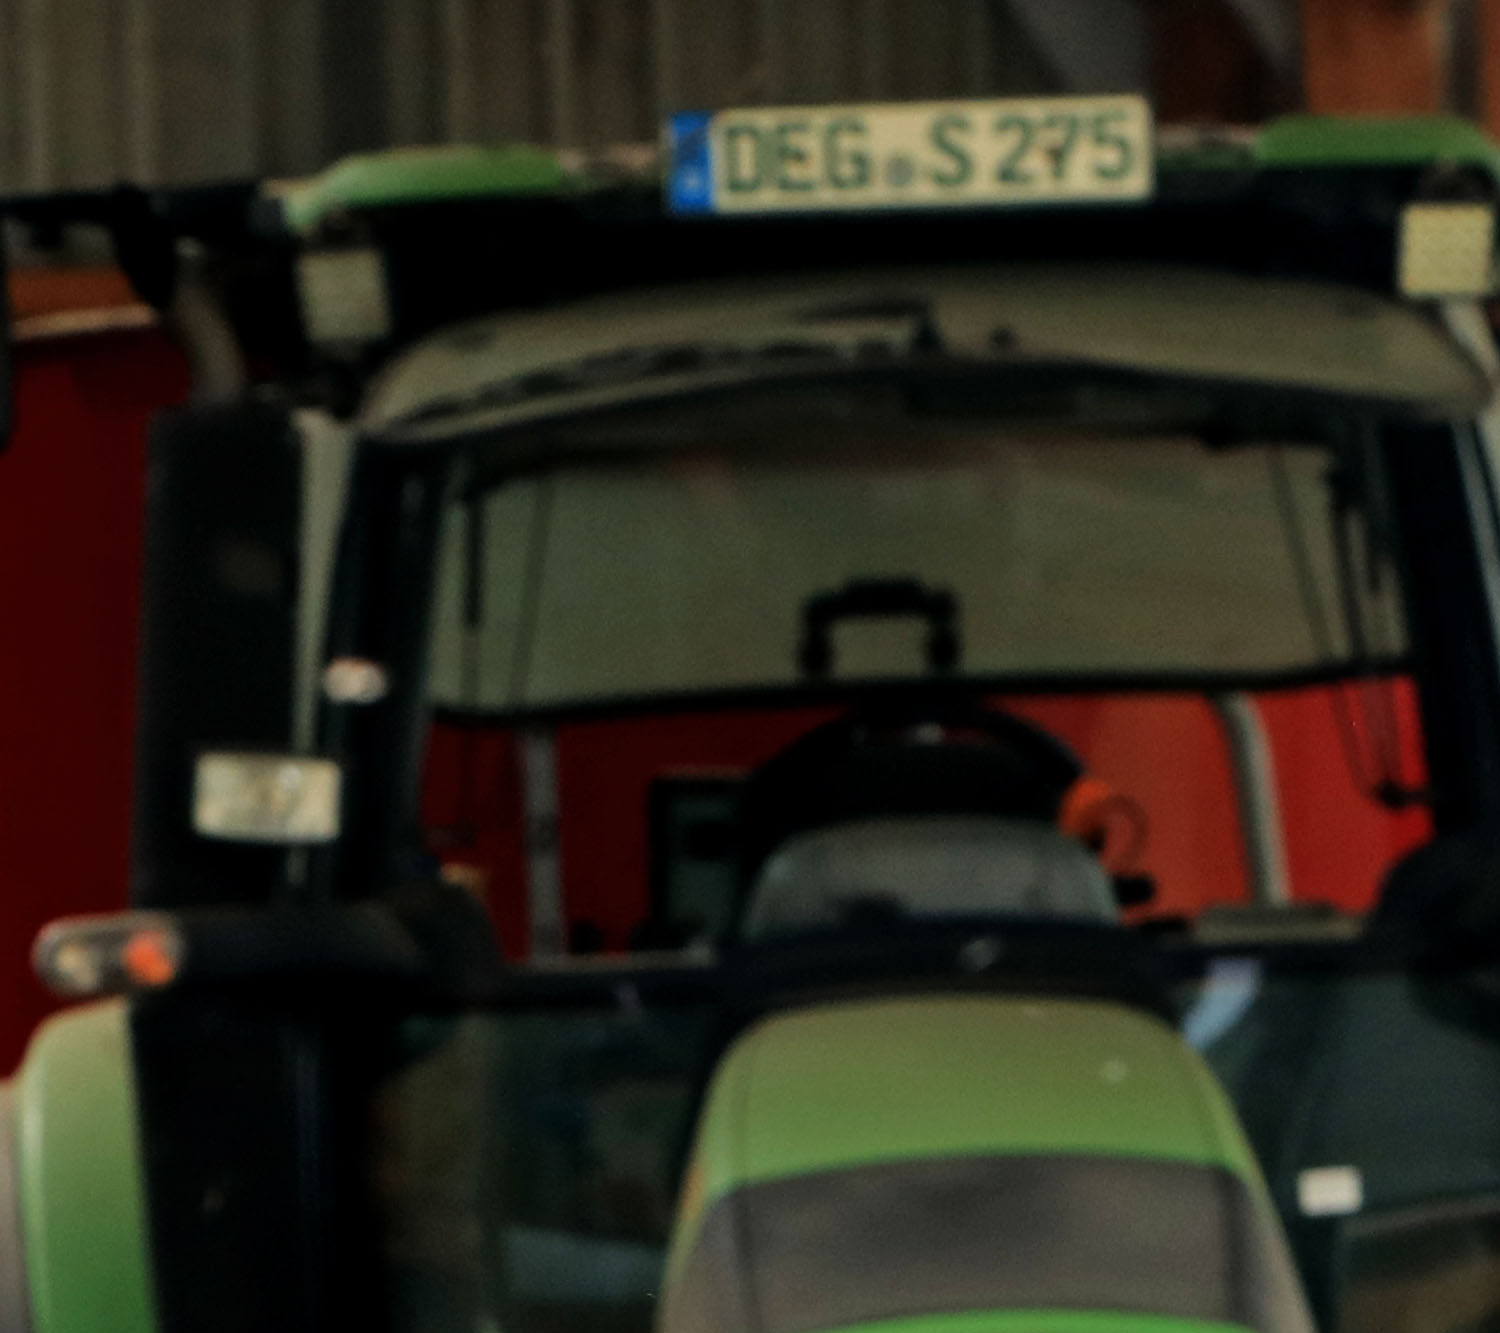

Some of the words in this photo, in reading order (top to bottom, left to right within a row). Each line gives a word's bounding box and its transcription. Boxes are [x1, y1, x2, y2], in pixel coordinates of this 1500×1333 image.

[724, 115, 870, 194] DEG
[929, 112, 976, 188] S
[992, 109, 1134, 185] 275
